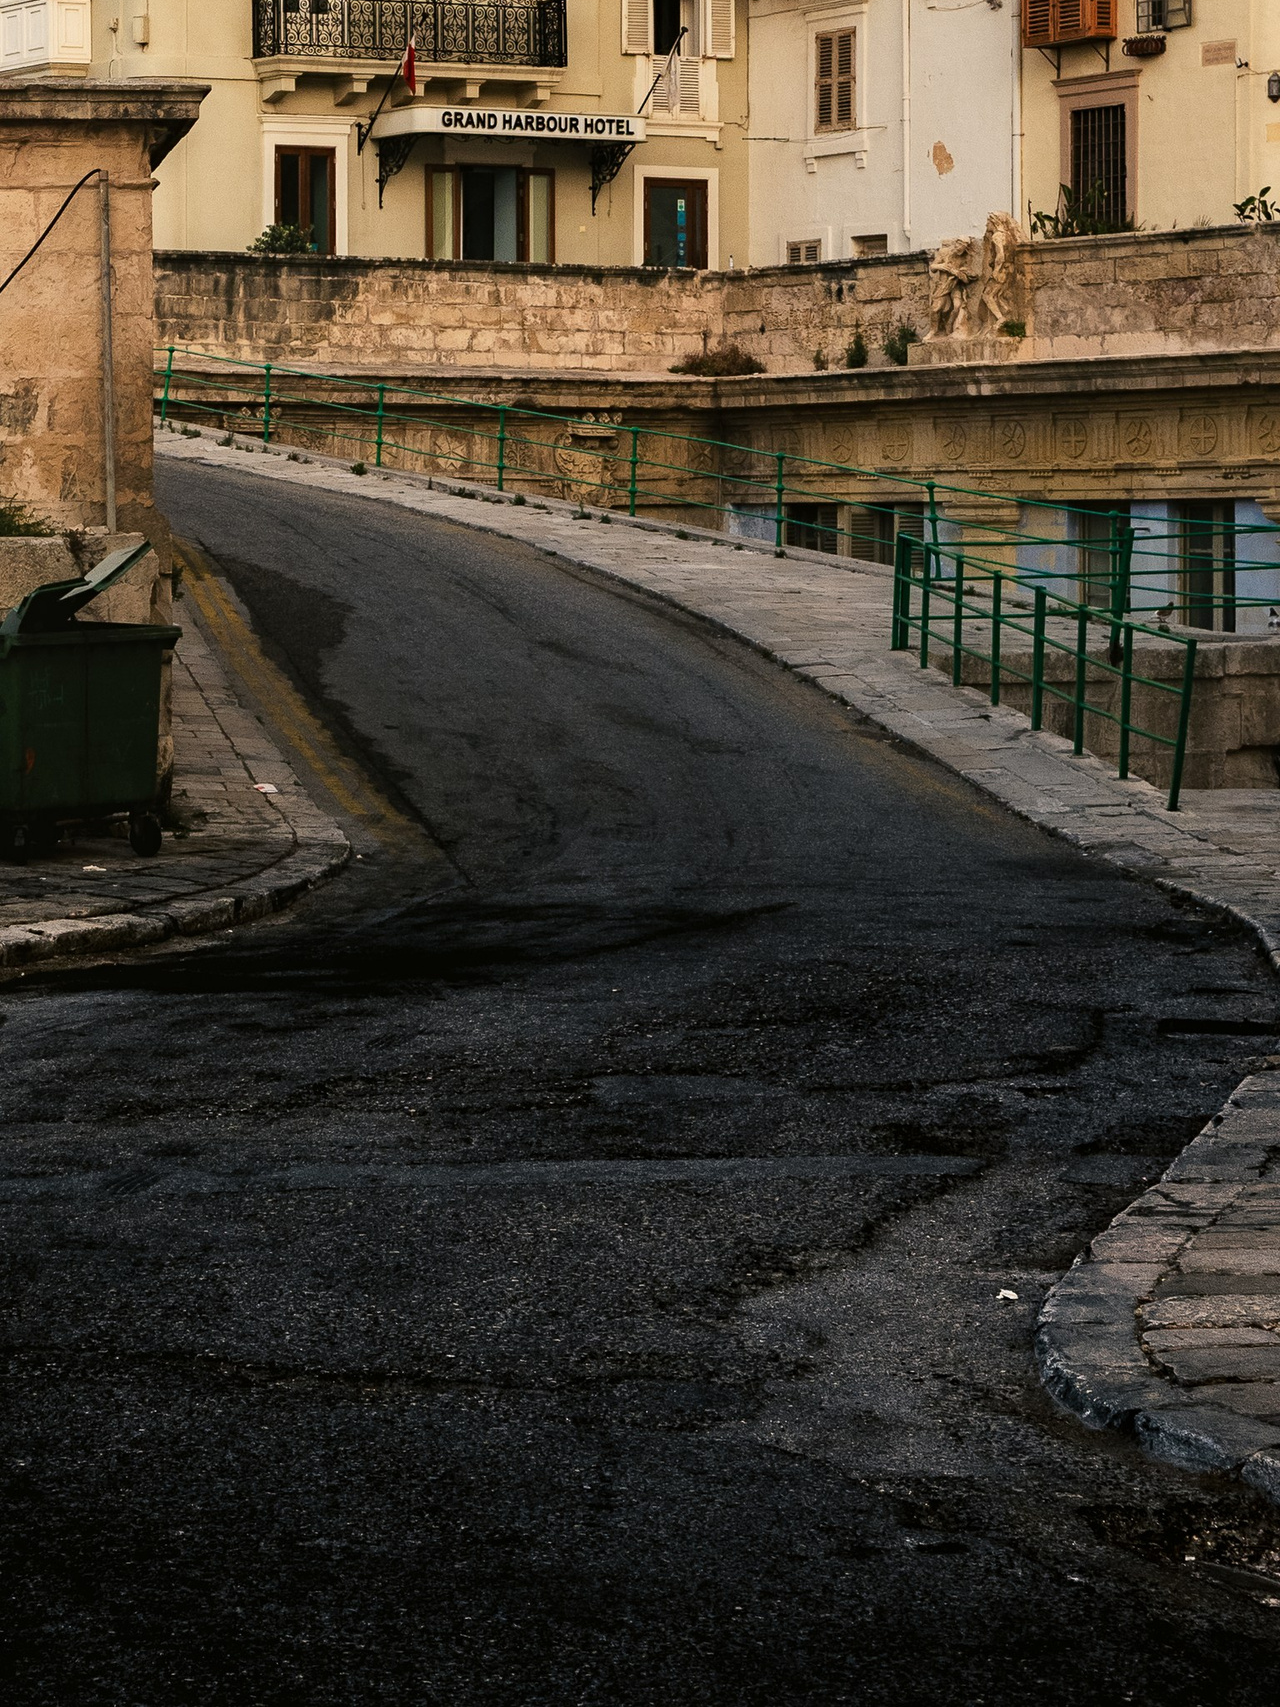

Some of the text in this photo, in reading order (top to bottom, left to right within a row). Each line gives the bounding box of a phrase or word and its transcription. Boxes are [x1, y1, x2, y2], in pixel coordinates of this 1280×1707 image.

[441, 110, 635, 136] GRAND HARBOUR HOTEL
